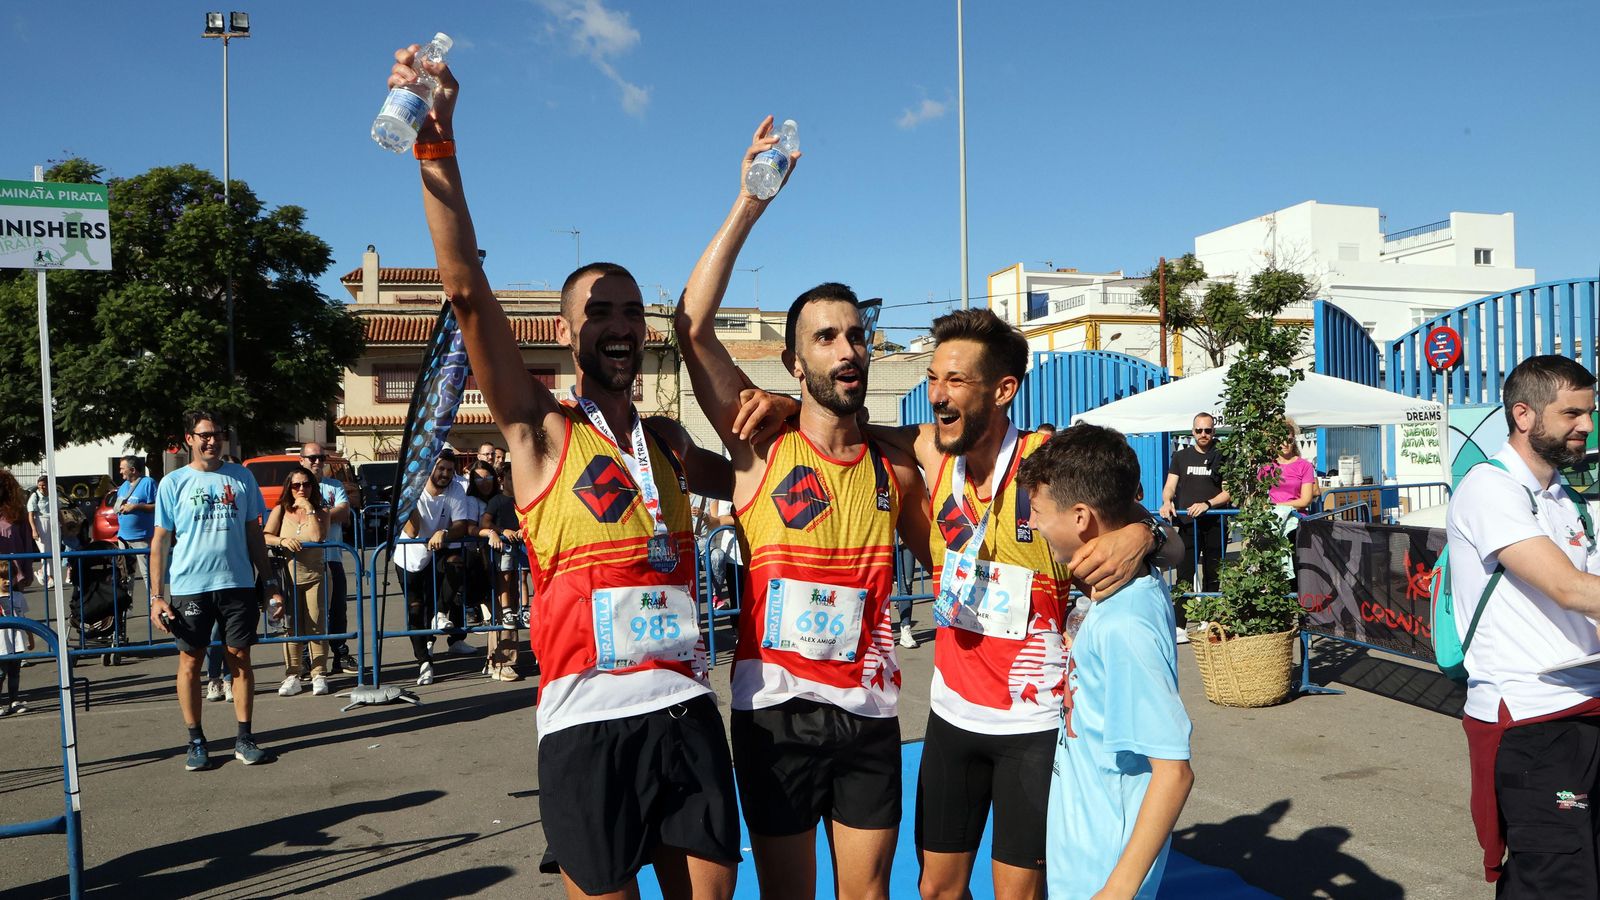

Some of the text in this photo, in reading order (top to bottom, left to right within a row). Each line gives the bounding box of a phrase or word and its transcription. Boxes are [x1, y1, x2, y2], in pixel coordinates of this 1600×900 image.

[0, 187, 104, 202] MINATA PIRATA
[1406, 411, 1441, 421] DREAMS
[769, 583, 785, 644] PIRATILL
[796, 609, 844, 636] 696
[630, 613, 680, 641] 985
[800, 635, 837, 645] ALEX AMIGO
